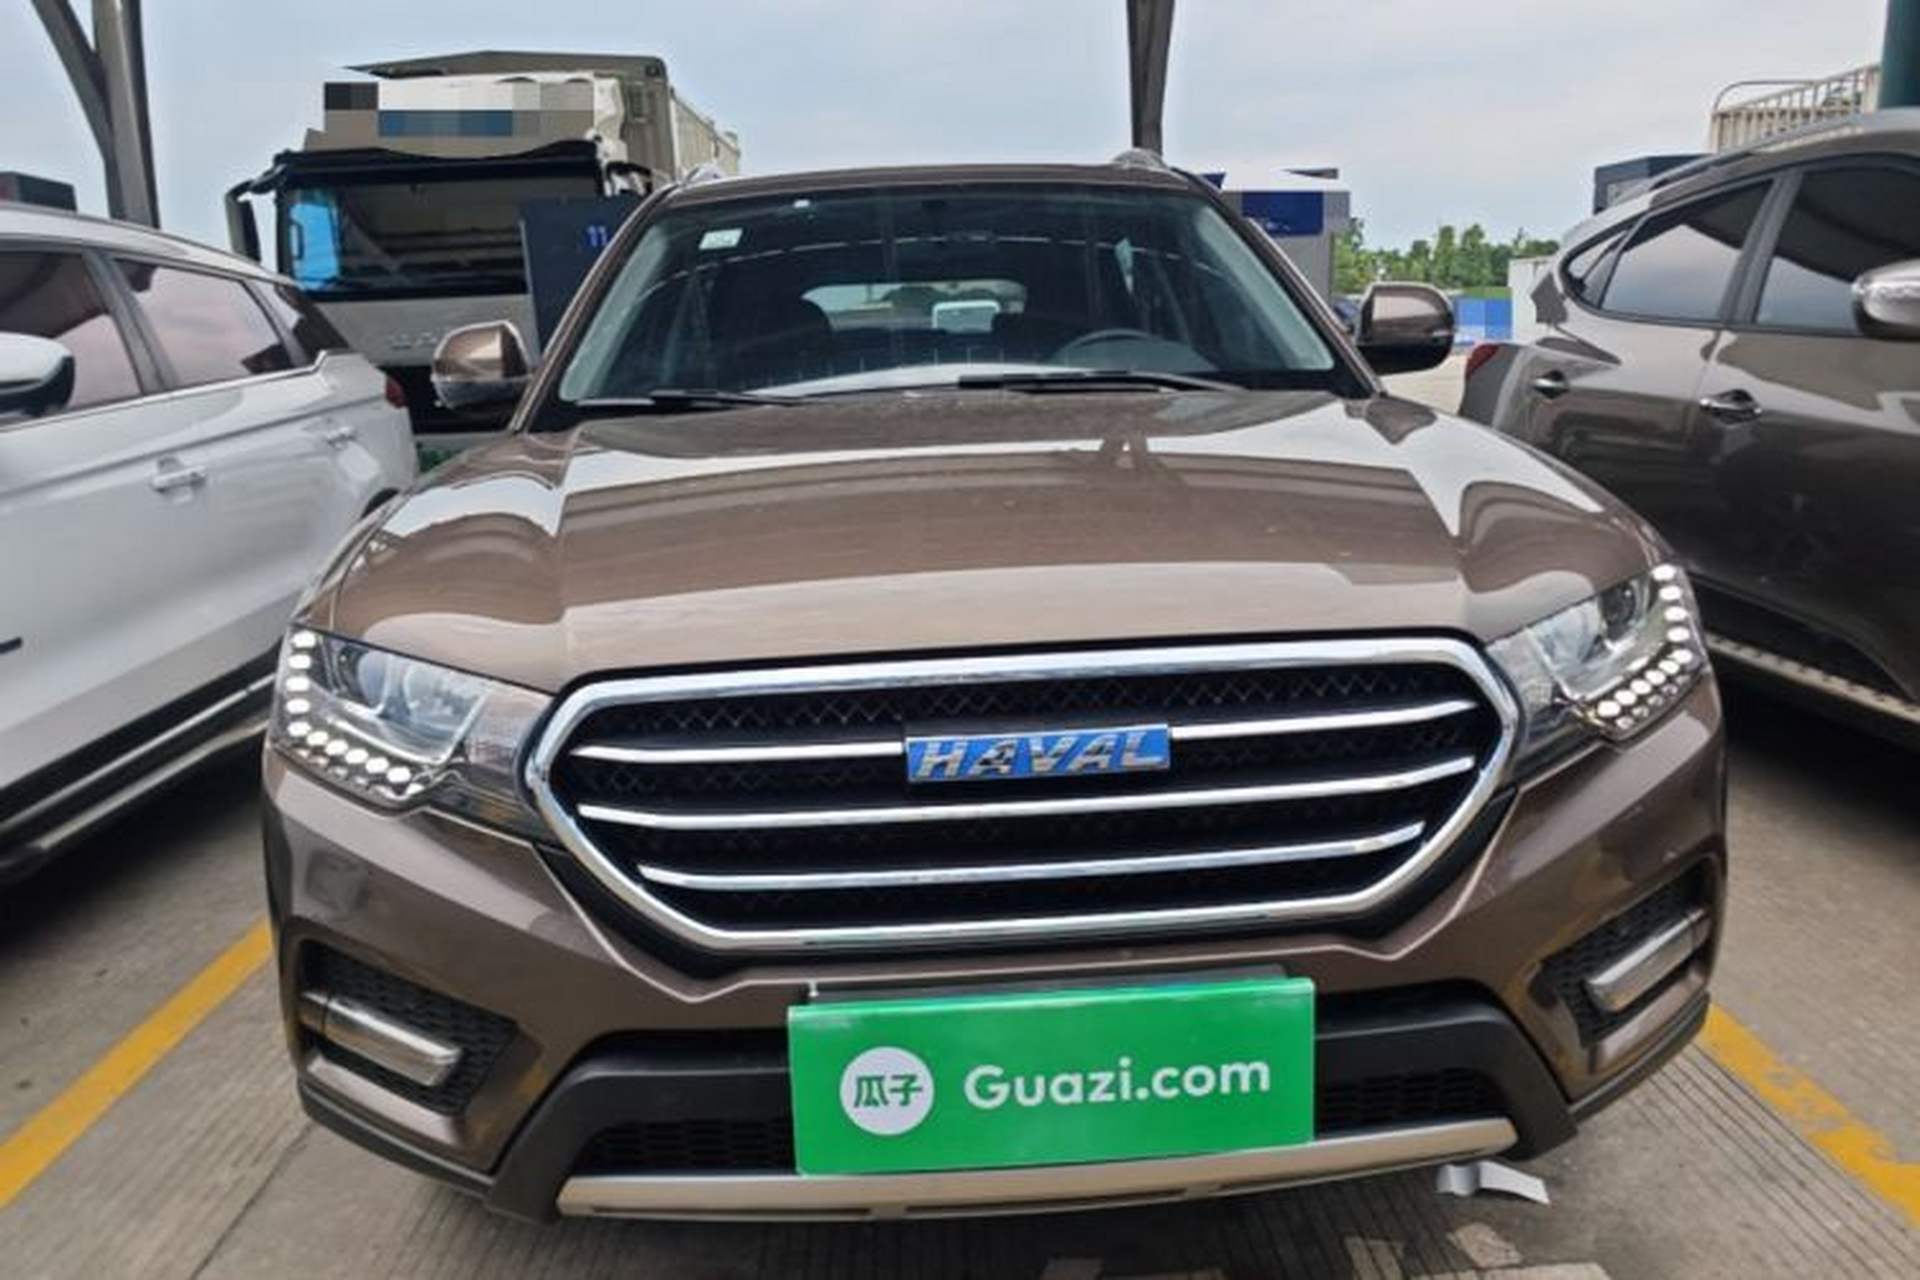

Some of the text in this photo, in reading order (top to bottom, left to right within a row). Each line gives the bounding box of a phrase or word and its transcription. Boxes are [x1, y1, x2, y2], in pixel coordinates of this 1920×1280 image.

[914, 731, 1163, 777] HAVAL
[853, 1073, 924, 1108] 瓜子
[963, 1056, 1271, 1110] Guazi.com
